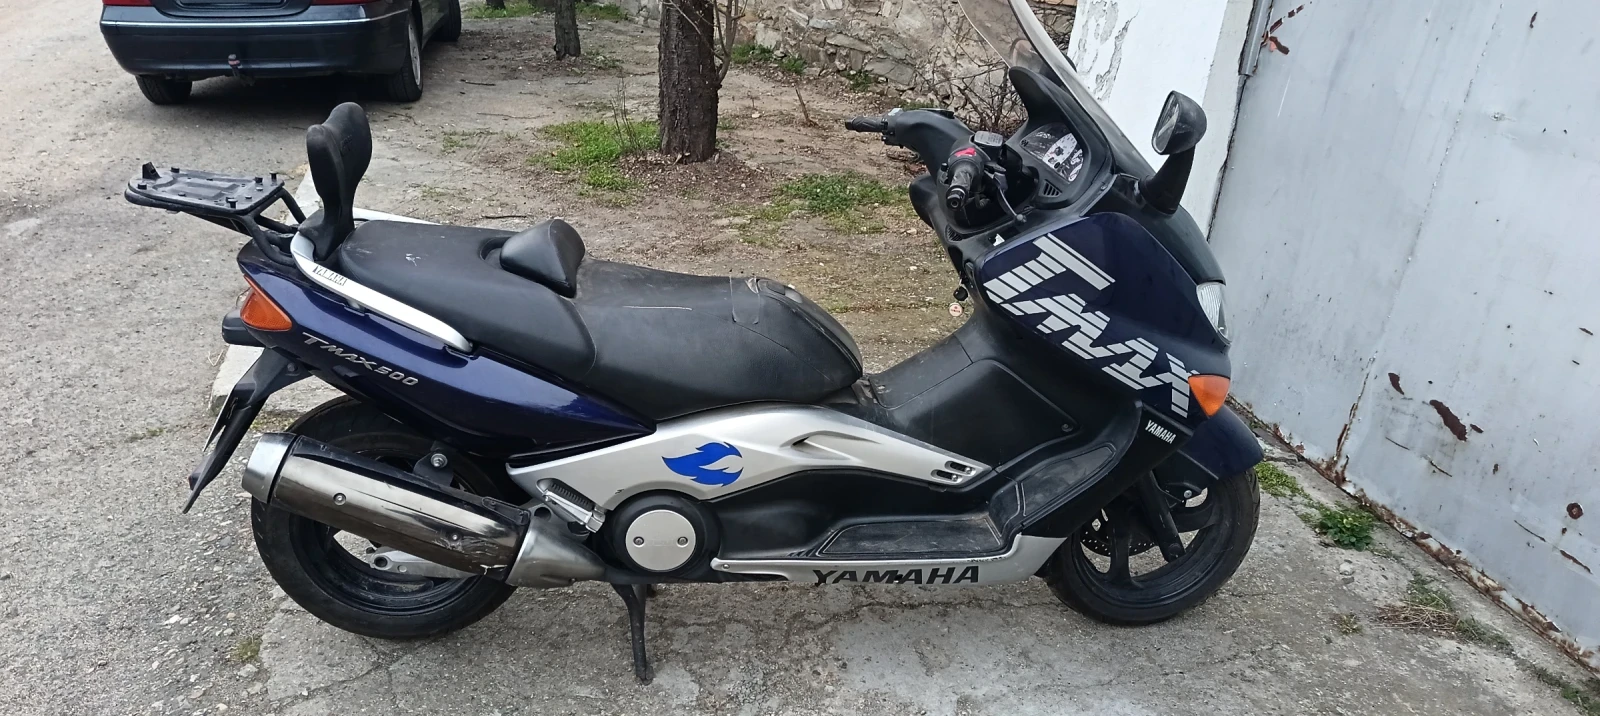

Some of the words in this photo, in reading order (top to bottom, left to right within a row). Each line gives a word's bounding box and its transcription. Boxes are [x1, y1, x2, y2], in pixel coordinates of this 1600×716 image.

[312, 264, 347, 286] YAMAHA
[1145, 420, 1177, 444] YAMAHA
[812, 566, 980, 585] YAMAHA
